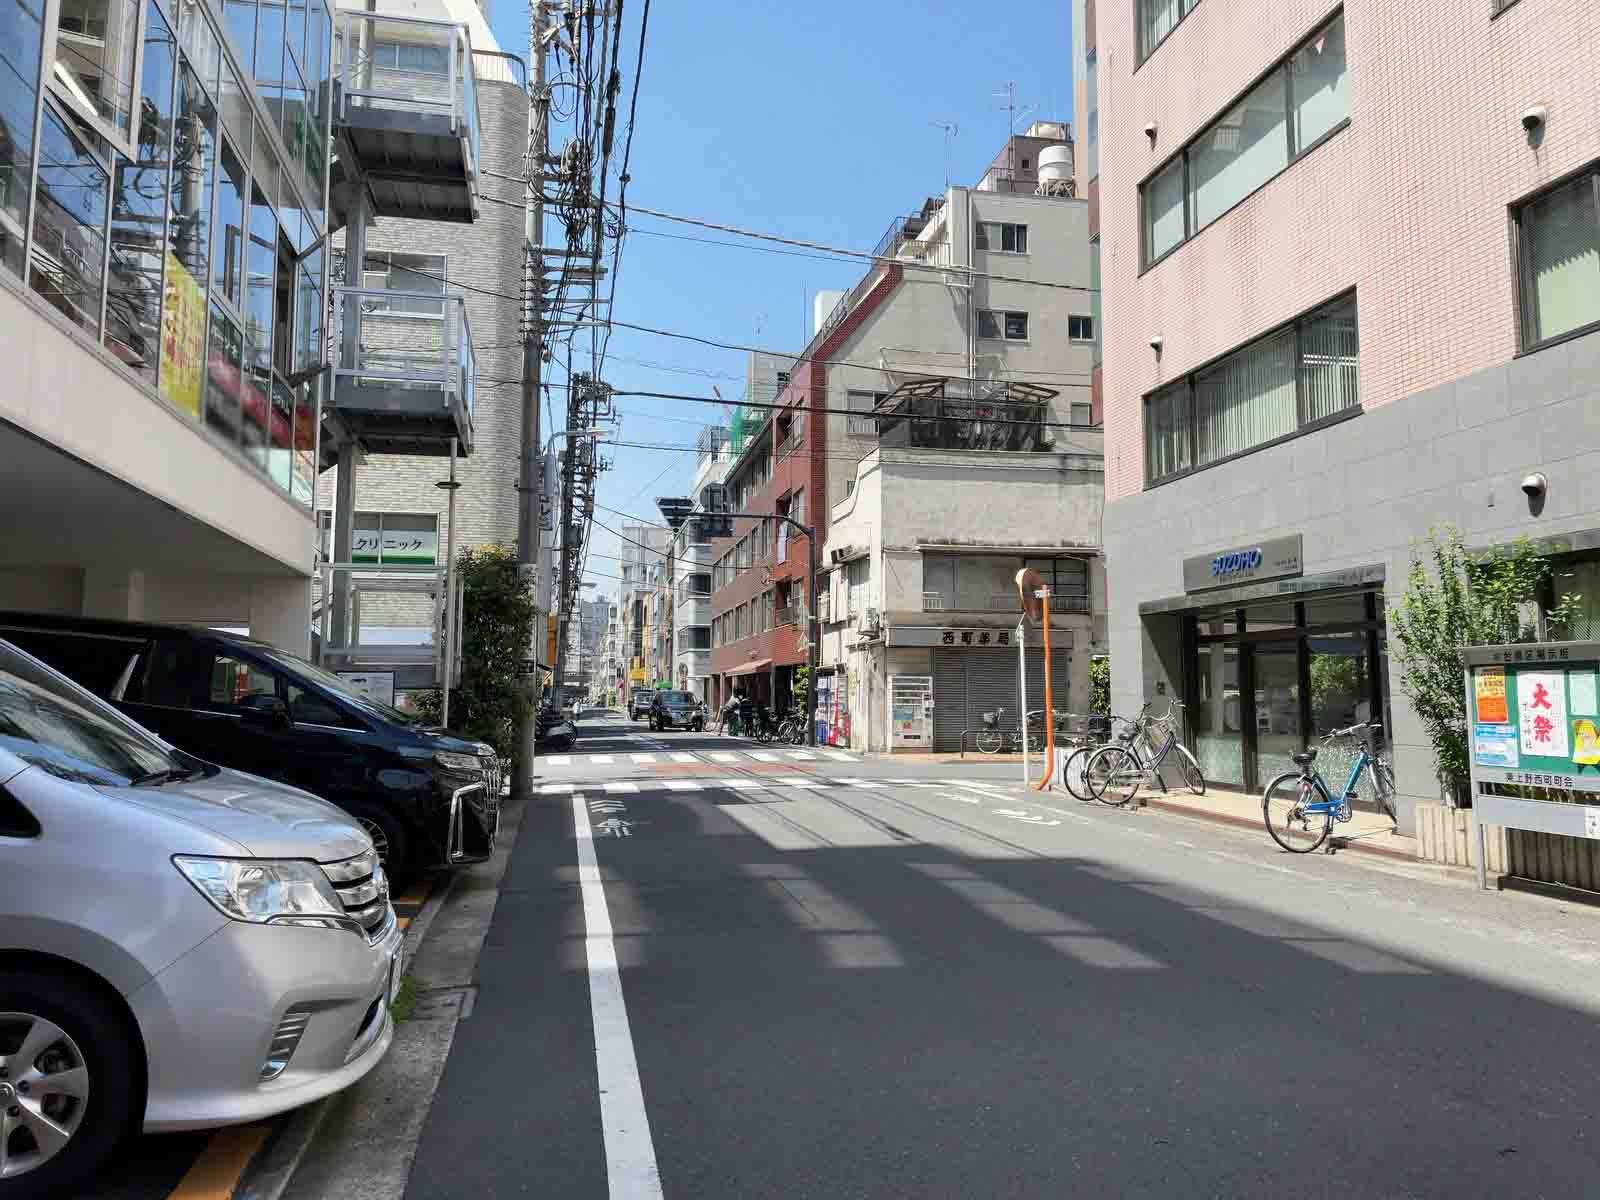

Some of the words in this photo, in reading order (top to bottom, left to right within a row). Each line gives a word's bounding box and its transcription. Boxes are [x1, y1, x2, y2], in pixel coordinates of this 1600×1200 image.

[353, 537, 423, 551] クリニック
[1530, 682, 1553, 743] 大祭
